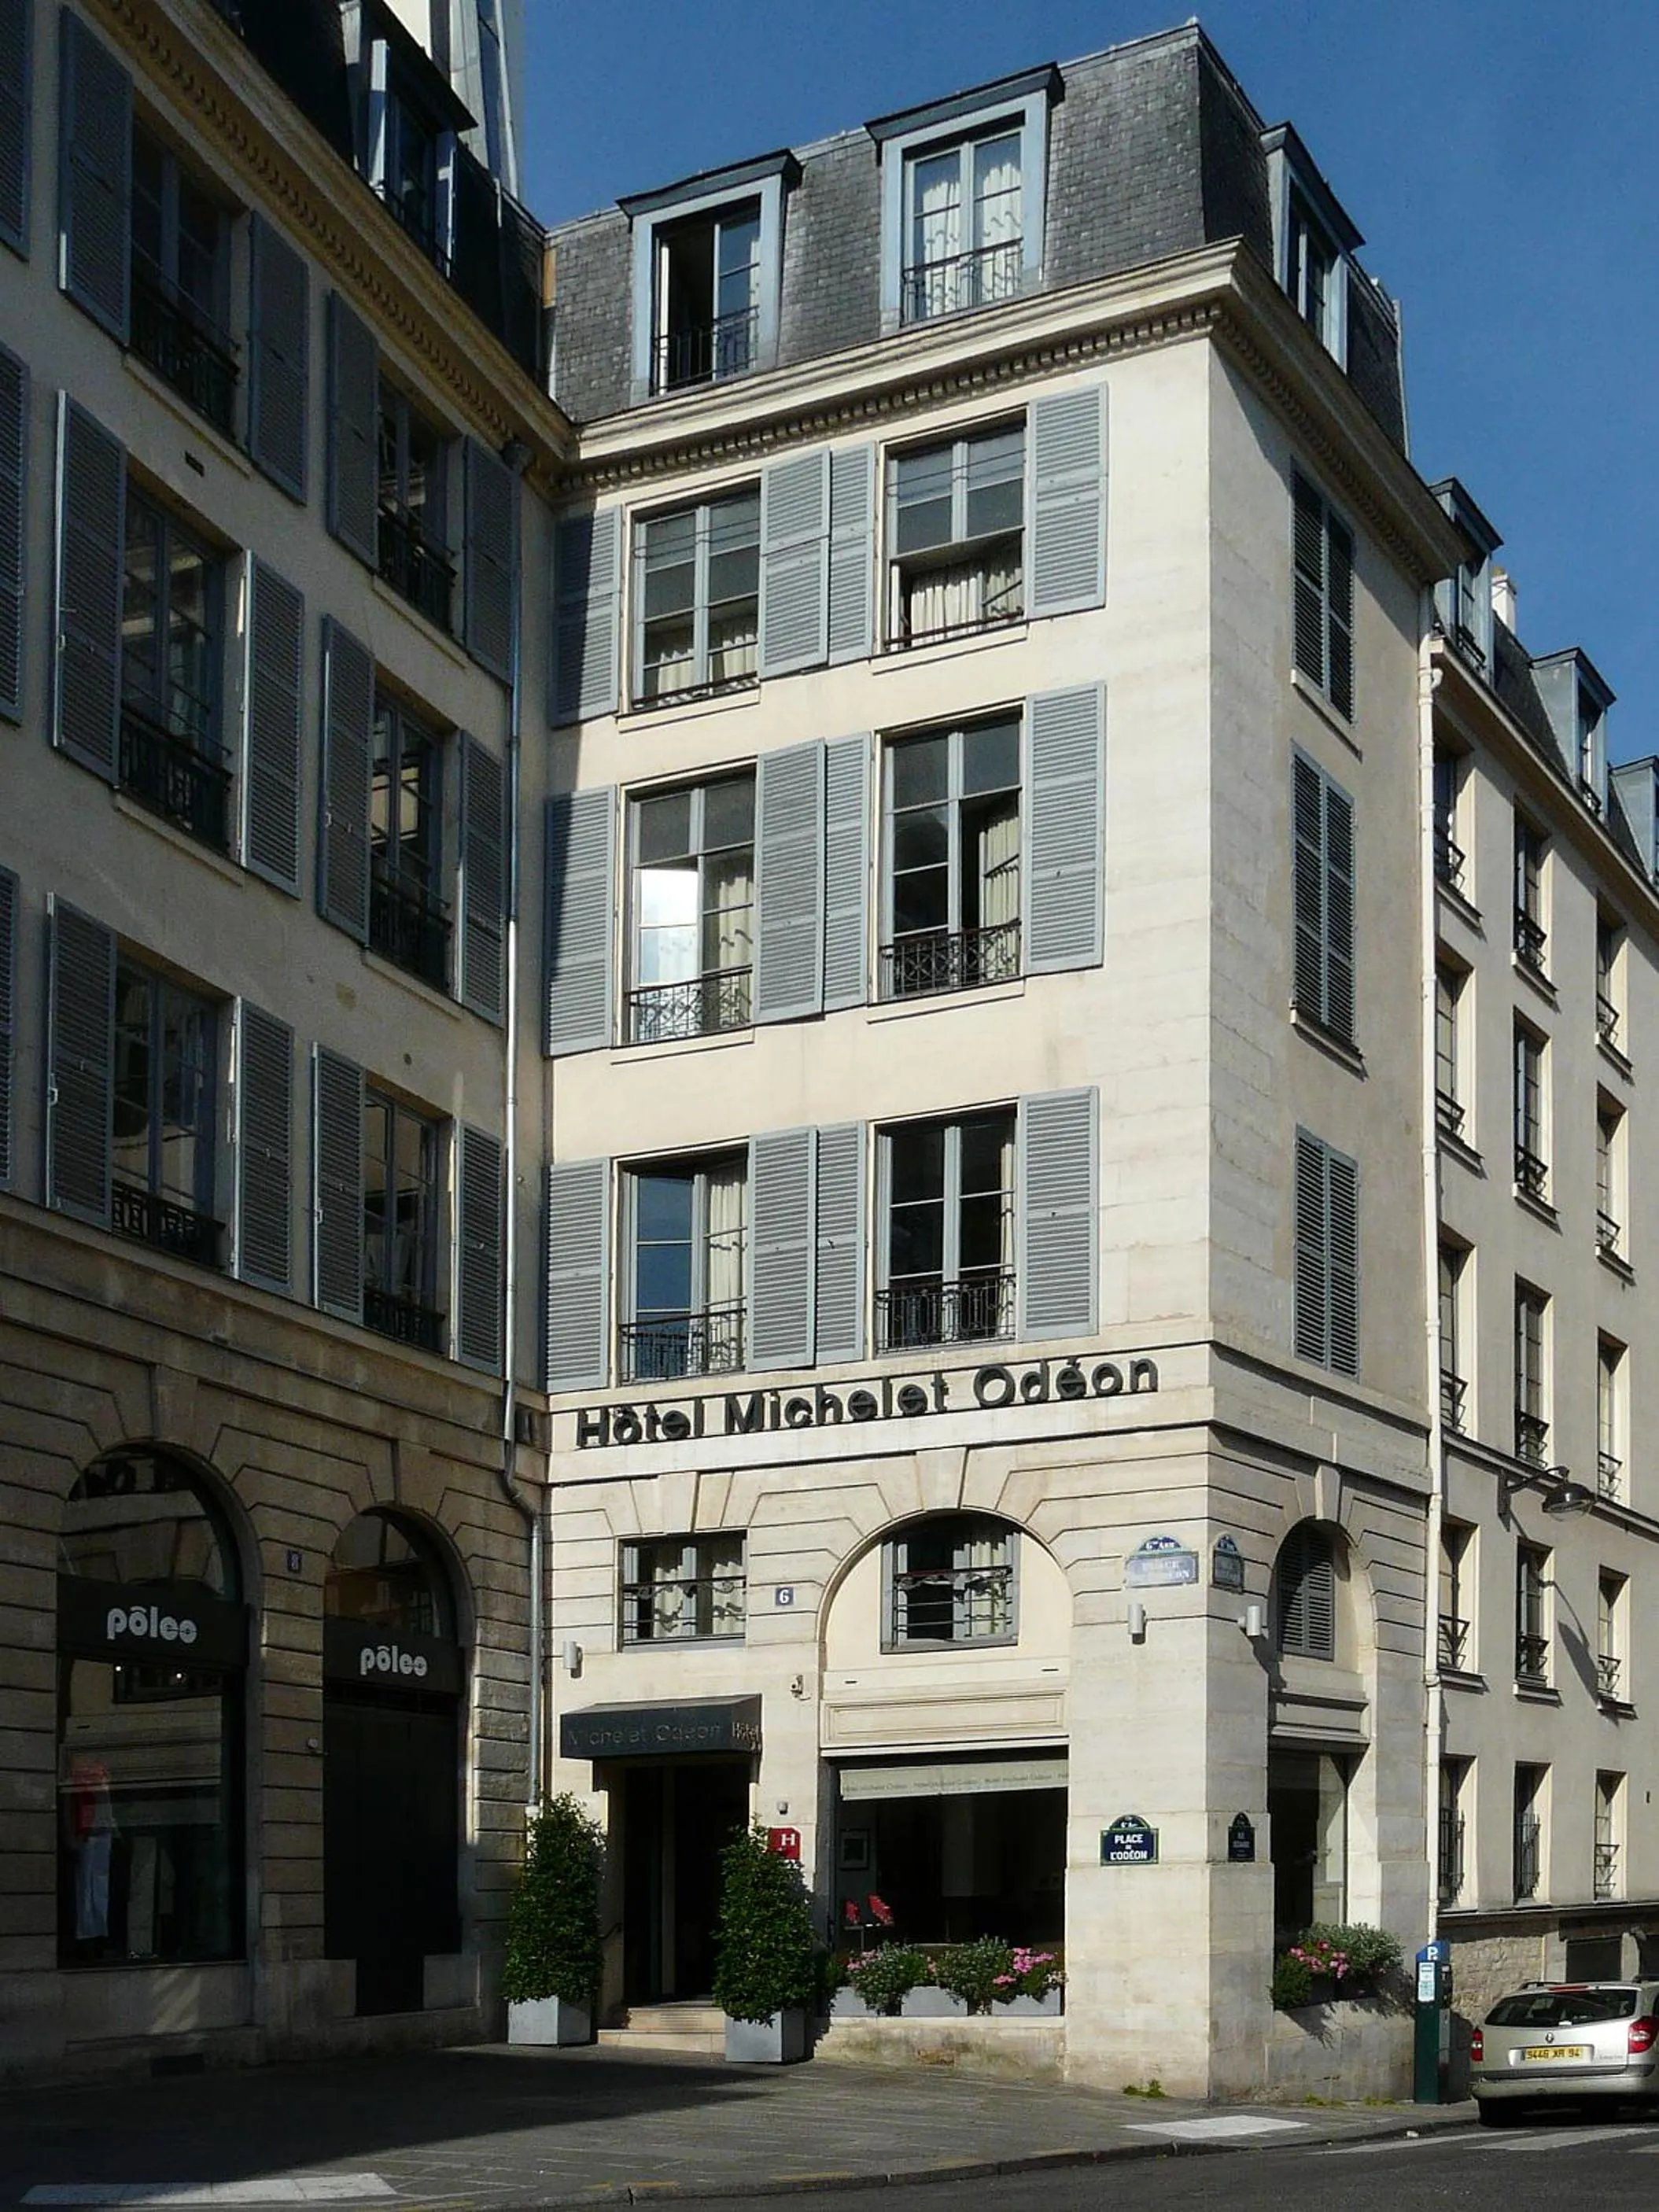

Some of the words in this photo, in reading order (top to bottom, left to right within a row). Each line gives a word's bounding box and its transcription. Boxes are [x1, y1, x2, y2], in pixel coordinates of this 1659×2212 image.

[577, 1397, 704, 1448] Hôtel
[724, 1370, 949, 1434] Michelet
[974, 1355, 1158, 1408] Odéon
[780, 1589, 790, 1603] 6
[781, 1834, 795, 1845] H
[1115, 1834, 1144, 1844] PLACE
[1427, 1946, 1438, 1960] P
